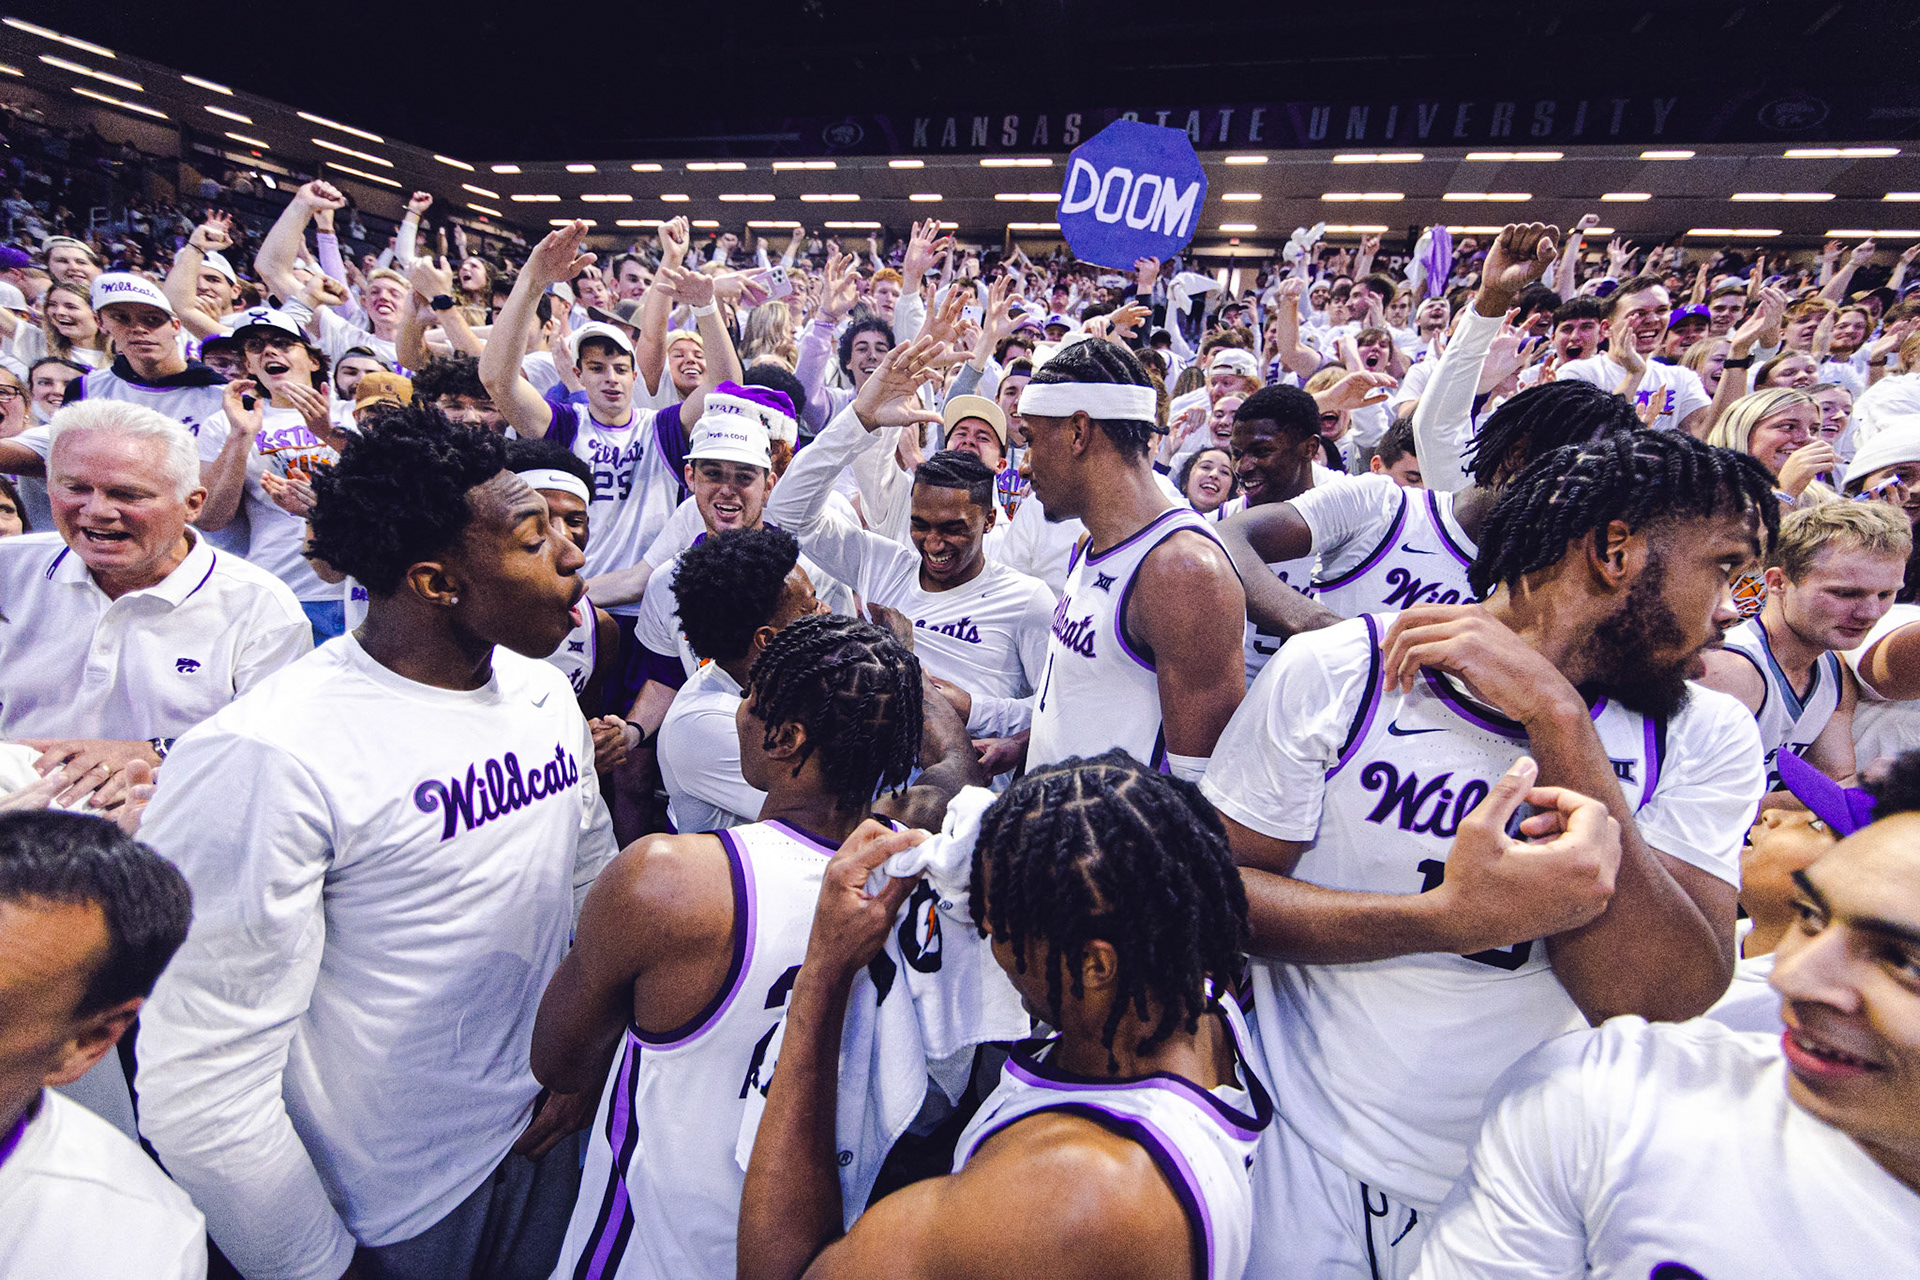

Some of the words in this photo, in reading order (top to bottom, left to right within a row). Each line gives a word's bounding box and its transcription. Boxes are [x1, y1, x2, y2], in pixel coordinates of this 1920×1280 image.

[912, 112, 1083, 149] KANSAS
[1307, 96, 1677, 141] UNIVERSITY
[1061, 157, 1201, 239] DOOM
[730, 433, 748, 442] cool
[592, 470, 632, 501] 25
[413, 740, 579, 843] Wildcats
